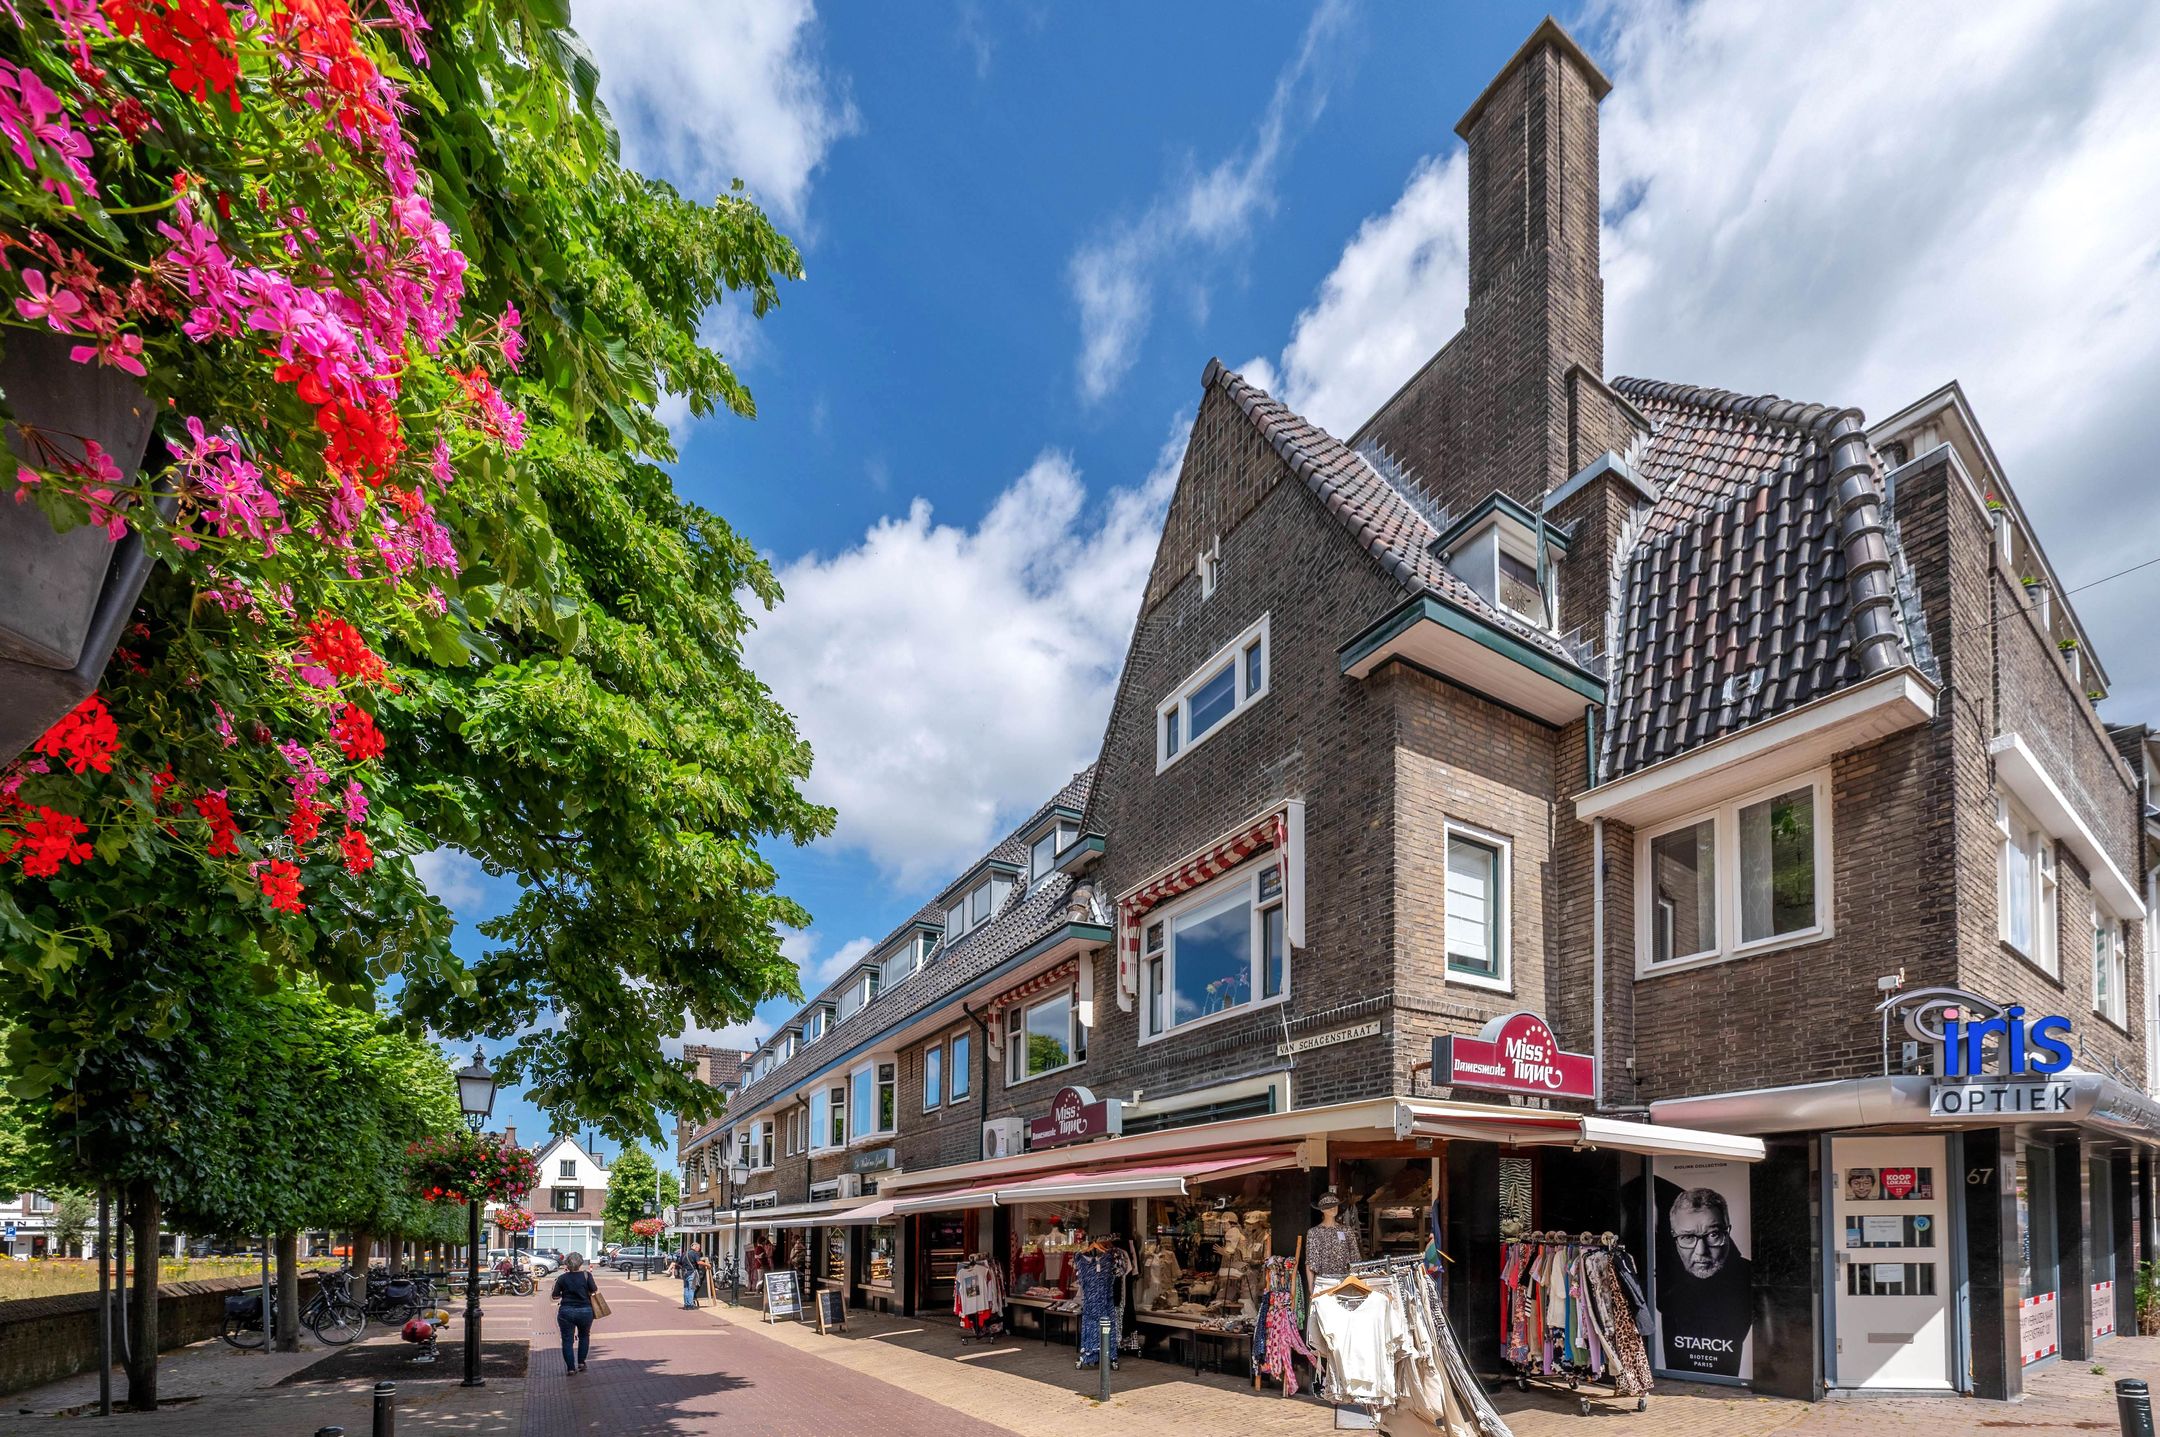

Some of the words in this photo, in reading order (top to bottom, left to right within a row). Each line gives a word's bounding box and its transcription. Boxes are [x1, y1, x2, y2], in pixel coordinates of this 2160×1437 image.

[1279, 1043, 1295, 1054] VAN
[1300, 1024, 1372, 1050] SCHAGENSTRAAT
[1943, 1006, 2073, 1076] iris
[1505, 1037, 1544, 1062] Miss
[1454, 1059, 1506, 1077] Damesmode
[1512, 1058, 1563, 1089] Tique
[1941, 1086, 2072, 1113] OPTIEK
[1055, 1104, 1076, 1121] Miss
[1059, 1118, 1087, 1135] Tique
[1966, 1168, 1994, 1185] 67
[1674, 1335, 1734, 1353] STARCK
[1689, 1353, 1718, 1362] BIOTECH
